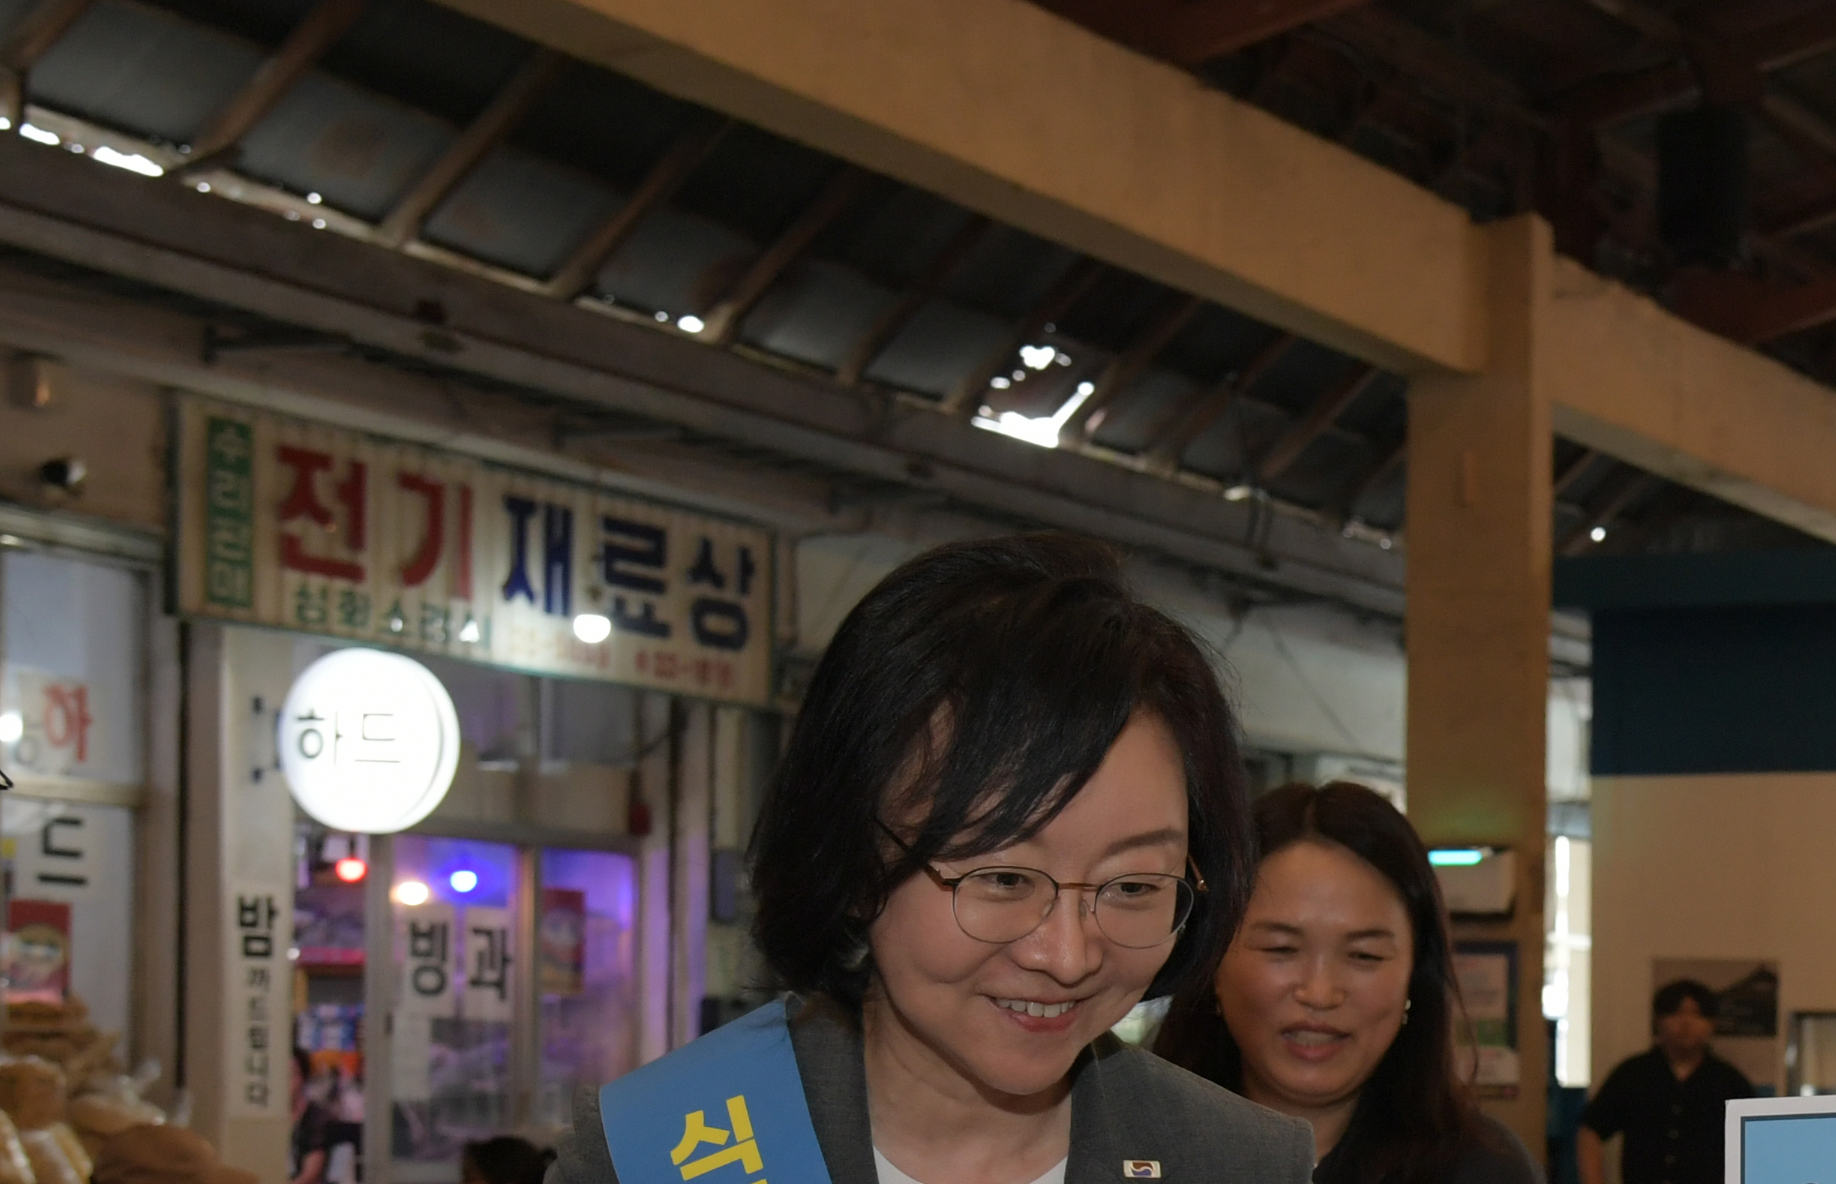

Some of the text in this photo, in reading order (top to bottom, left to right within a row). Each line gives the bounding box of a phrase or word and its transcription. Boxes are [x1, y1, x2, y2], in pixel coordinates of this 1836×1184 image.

[276, 444, 756, 653] 전기 재료상
[293, 708, 401, 766] 하드
[235, 895, 280, 959] 밤
